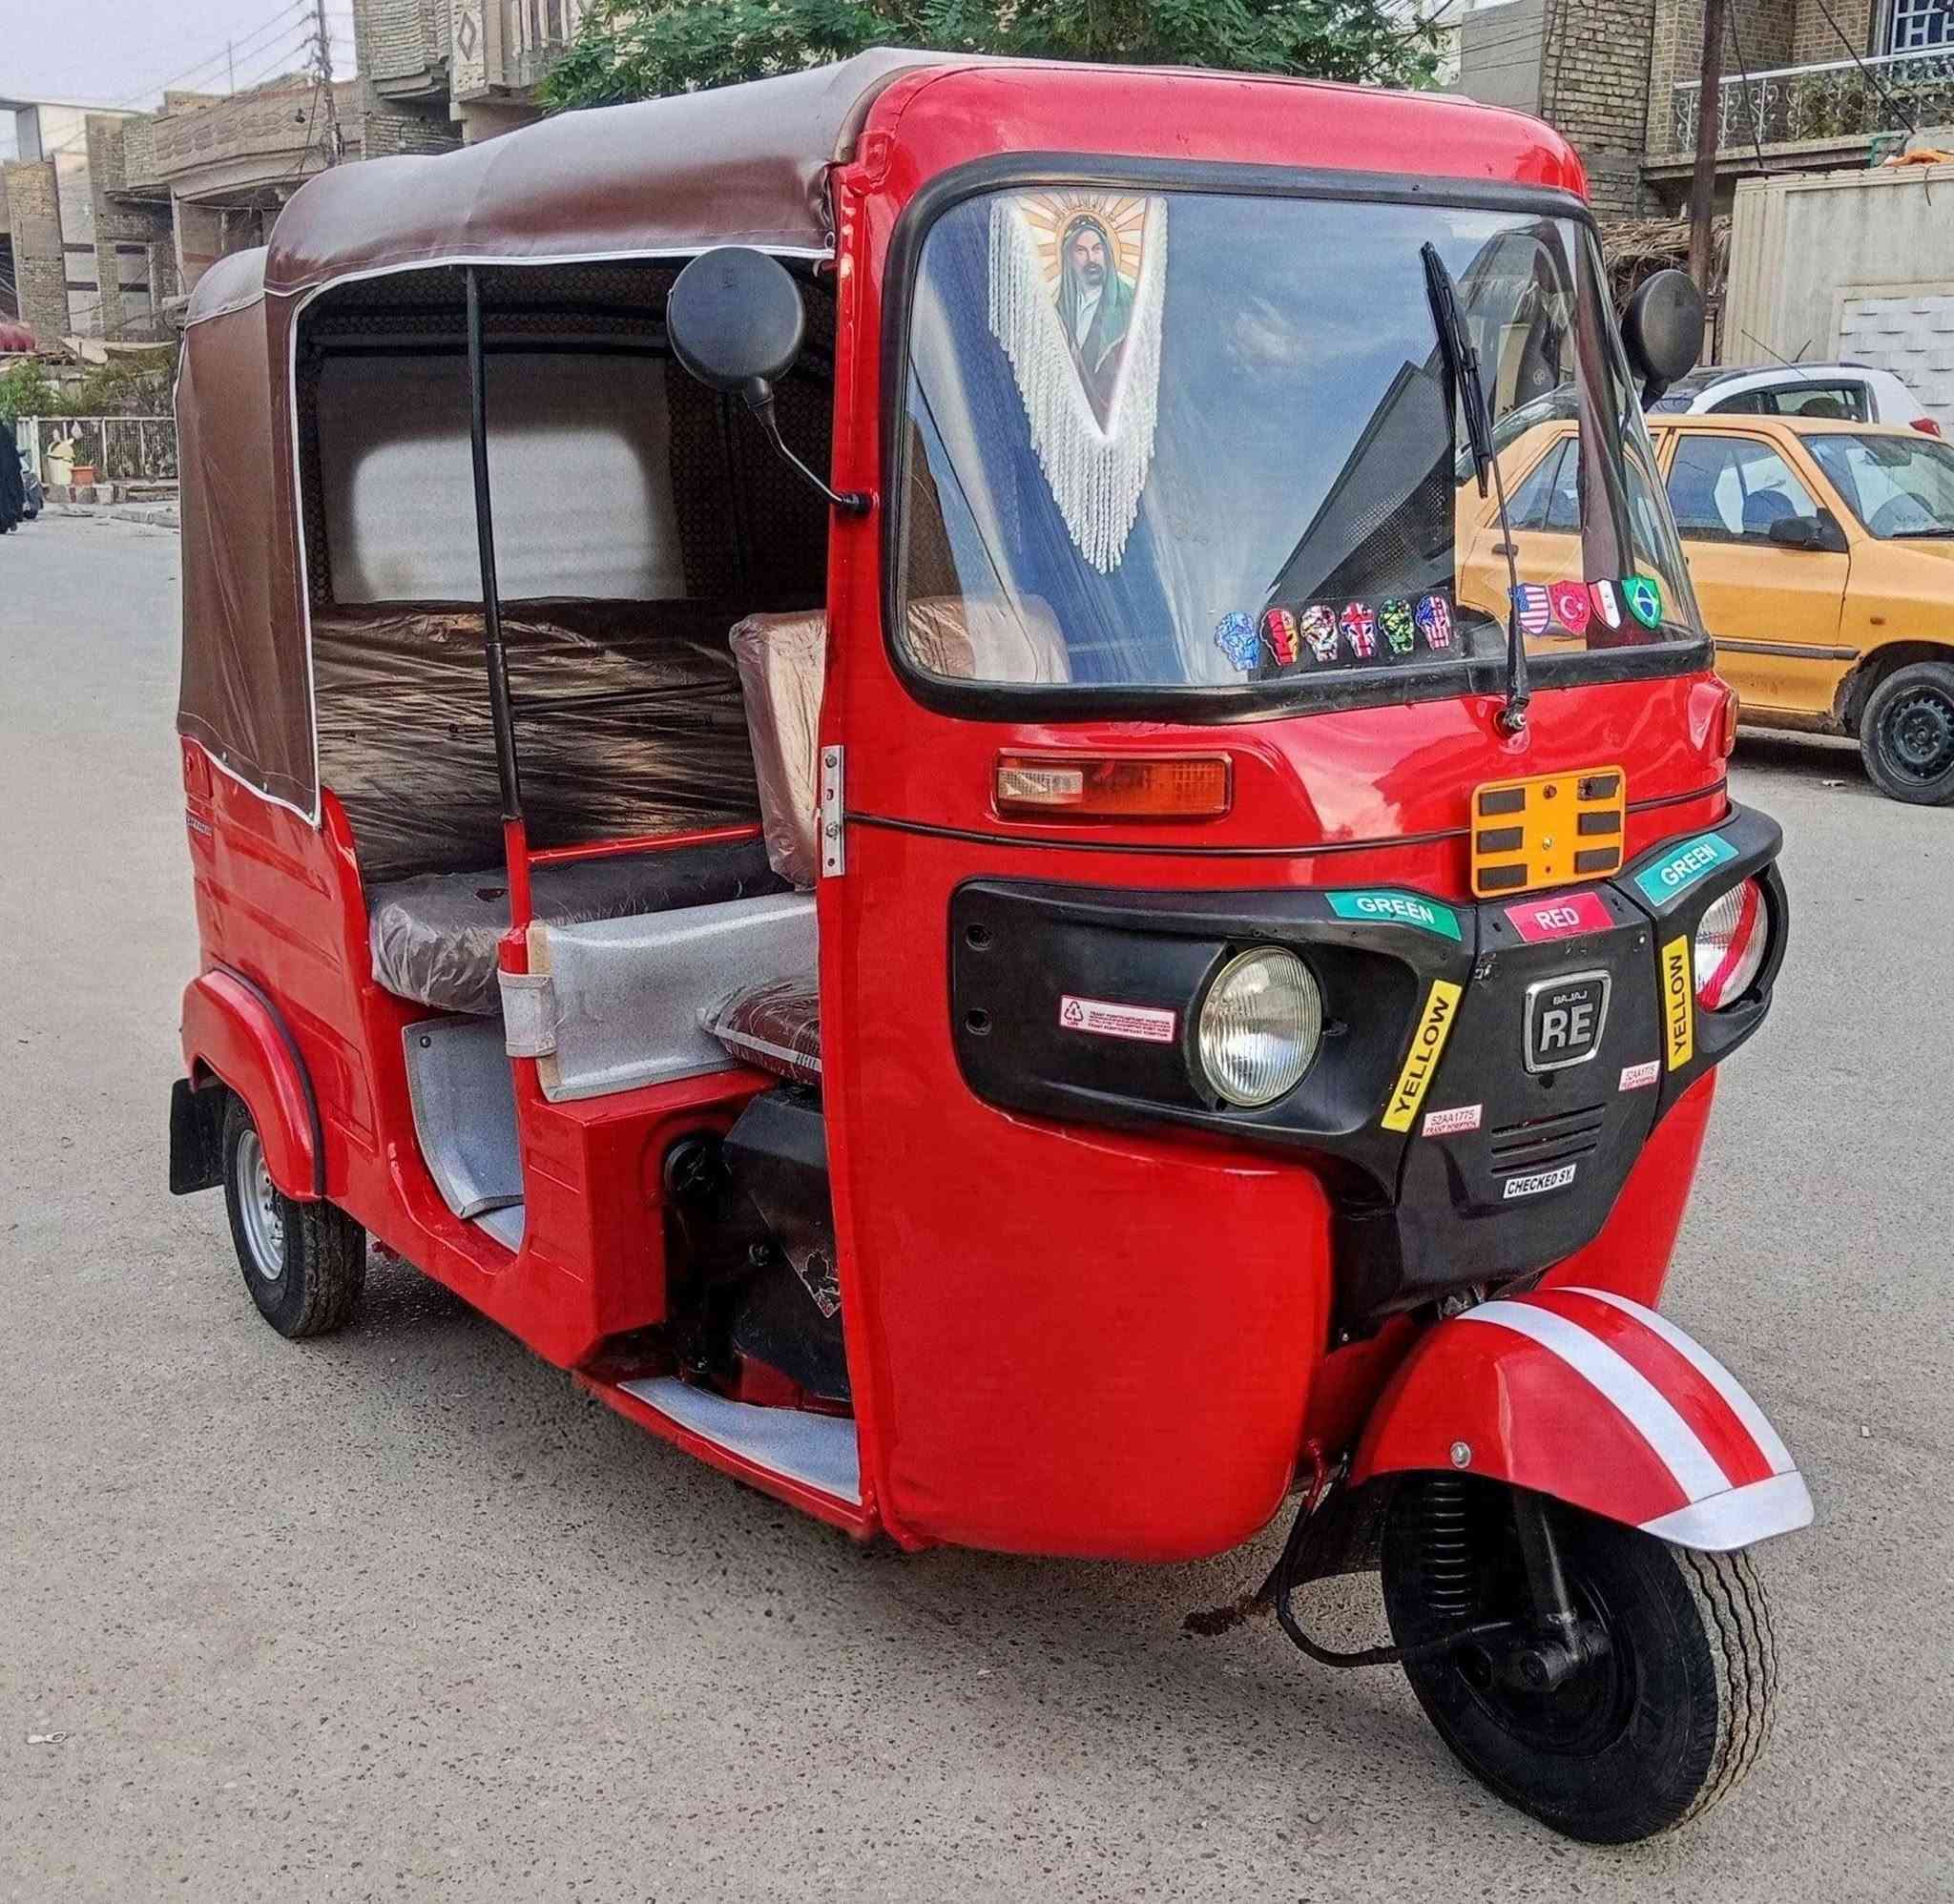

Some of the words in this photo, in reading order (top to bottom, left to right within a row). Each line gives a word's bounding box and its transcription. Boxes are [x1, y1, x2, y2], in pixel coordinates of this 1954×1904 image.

[1660, 843, 1718, 886] GREEN
[1356, 896, 1436, 924] GREEN
[1534, 907, 1580, 930] RED
[1552, 989, 1589, 1006] BAJAJ
[1669, 954, 1687, 1057] YELLOW
[1540, 1003, 1593, 1052] RE
[1394, 997, 1450, 1114] YELLOW
[1507, 1172, 1558, 1194] CHECKED
